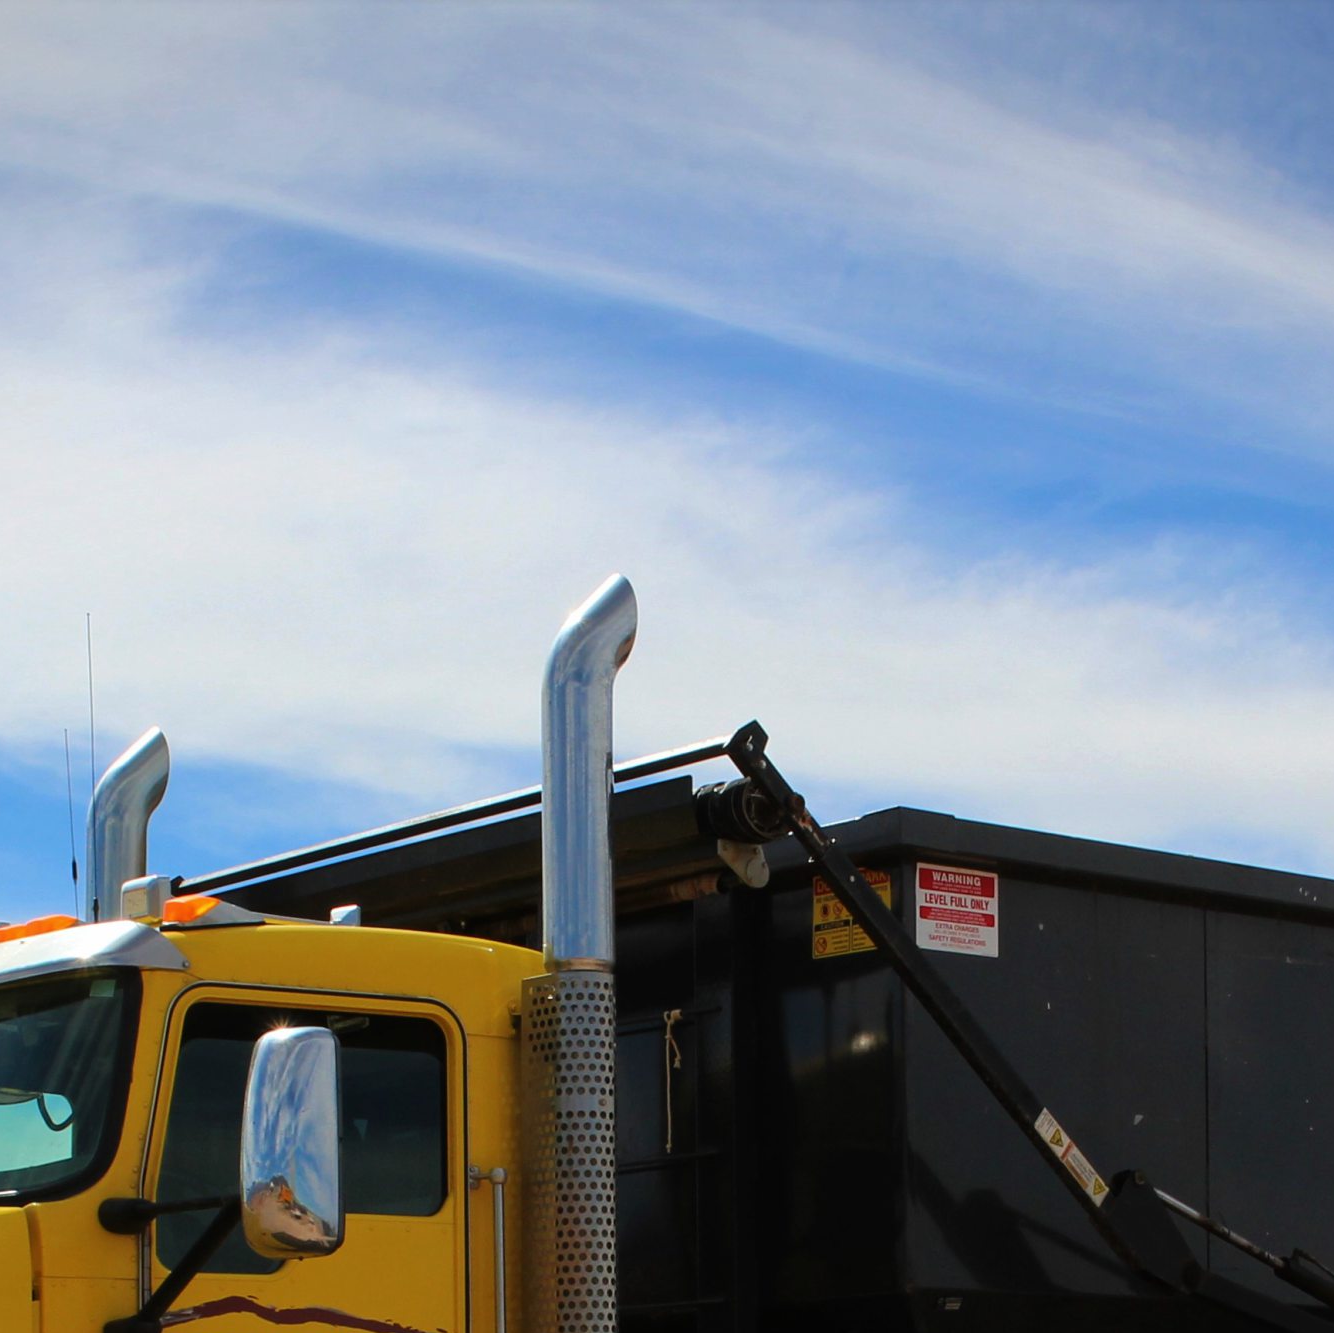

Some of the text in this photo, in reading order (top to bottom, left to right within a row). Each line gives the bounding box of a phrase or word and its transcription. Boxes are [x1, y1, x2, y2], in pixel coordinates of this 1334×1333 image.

[932, 871, 981, 887] WARNING
[924, 892, 990, 911] LEVEL FULL ONLY
